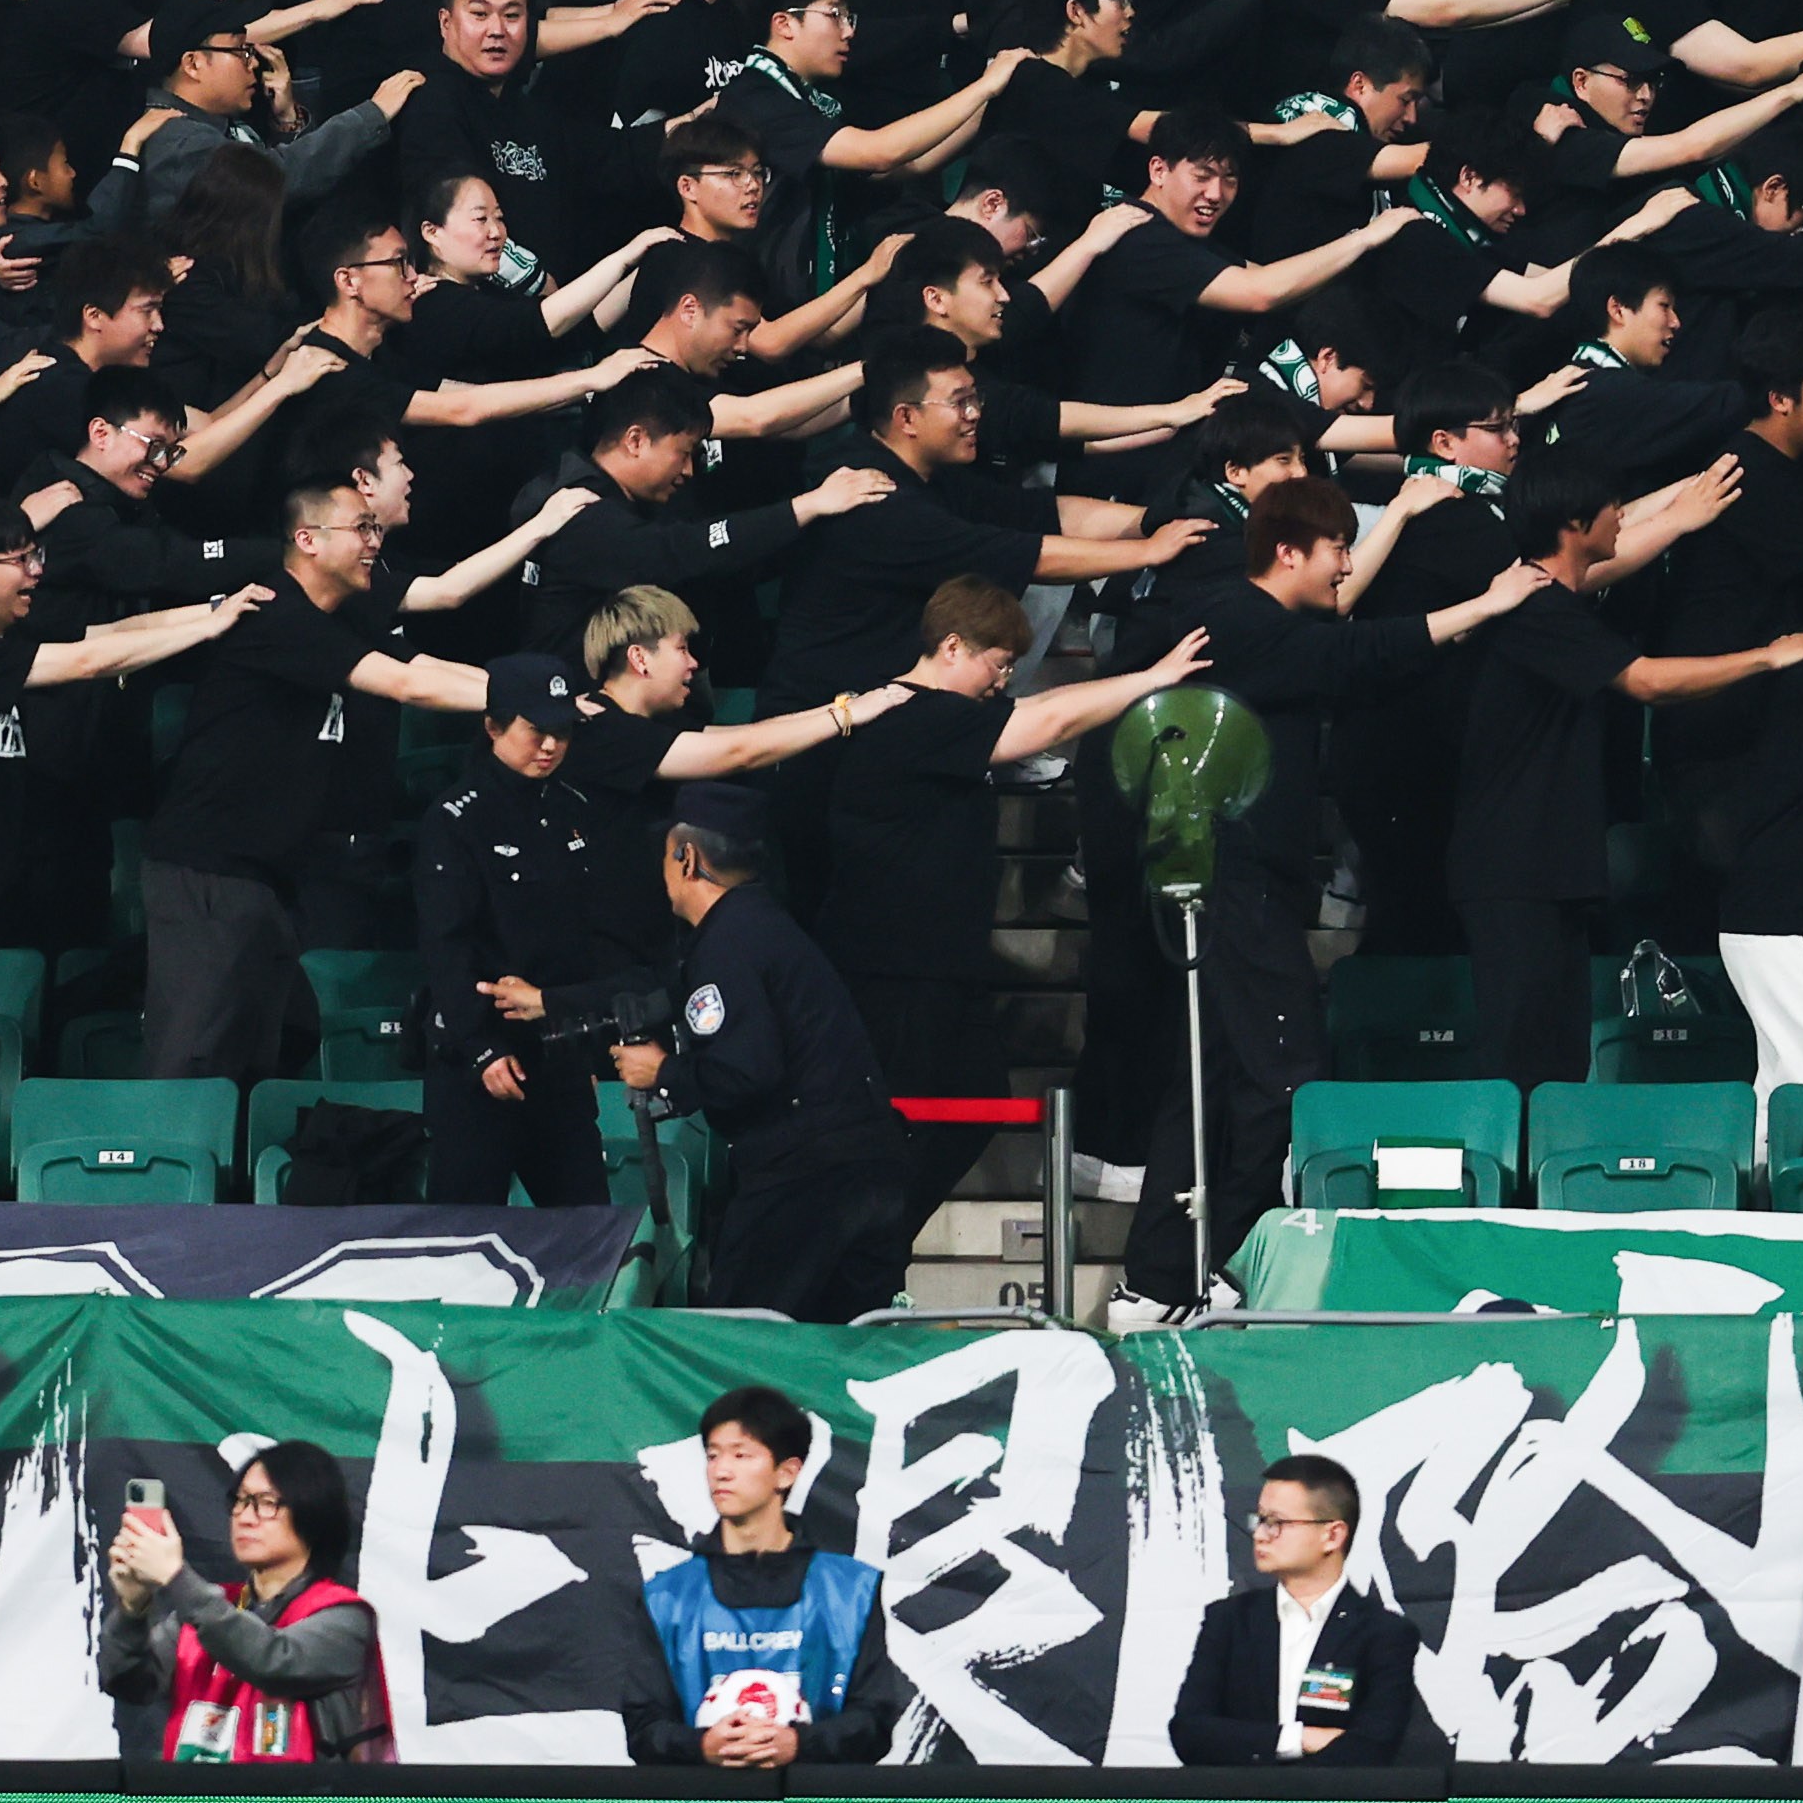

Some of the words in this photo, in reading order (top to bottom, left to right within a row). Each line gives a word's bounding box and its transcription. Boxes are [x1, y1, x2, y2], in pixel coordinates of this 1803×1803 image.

[108, 1152, 126, 1162] 14
[1629, 1158, 1647, 1169] 18
[703, 1634, 748, 1652] BALL
